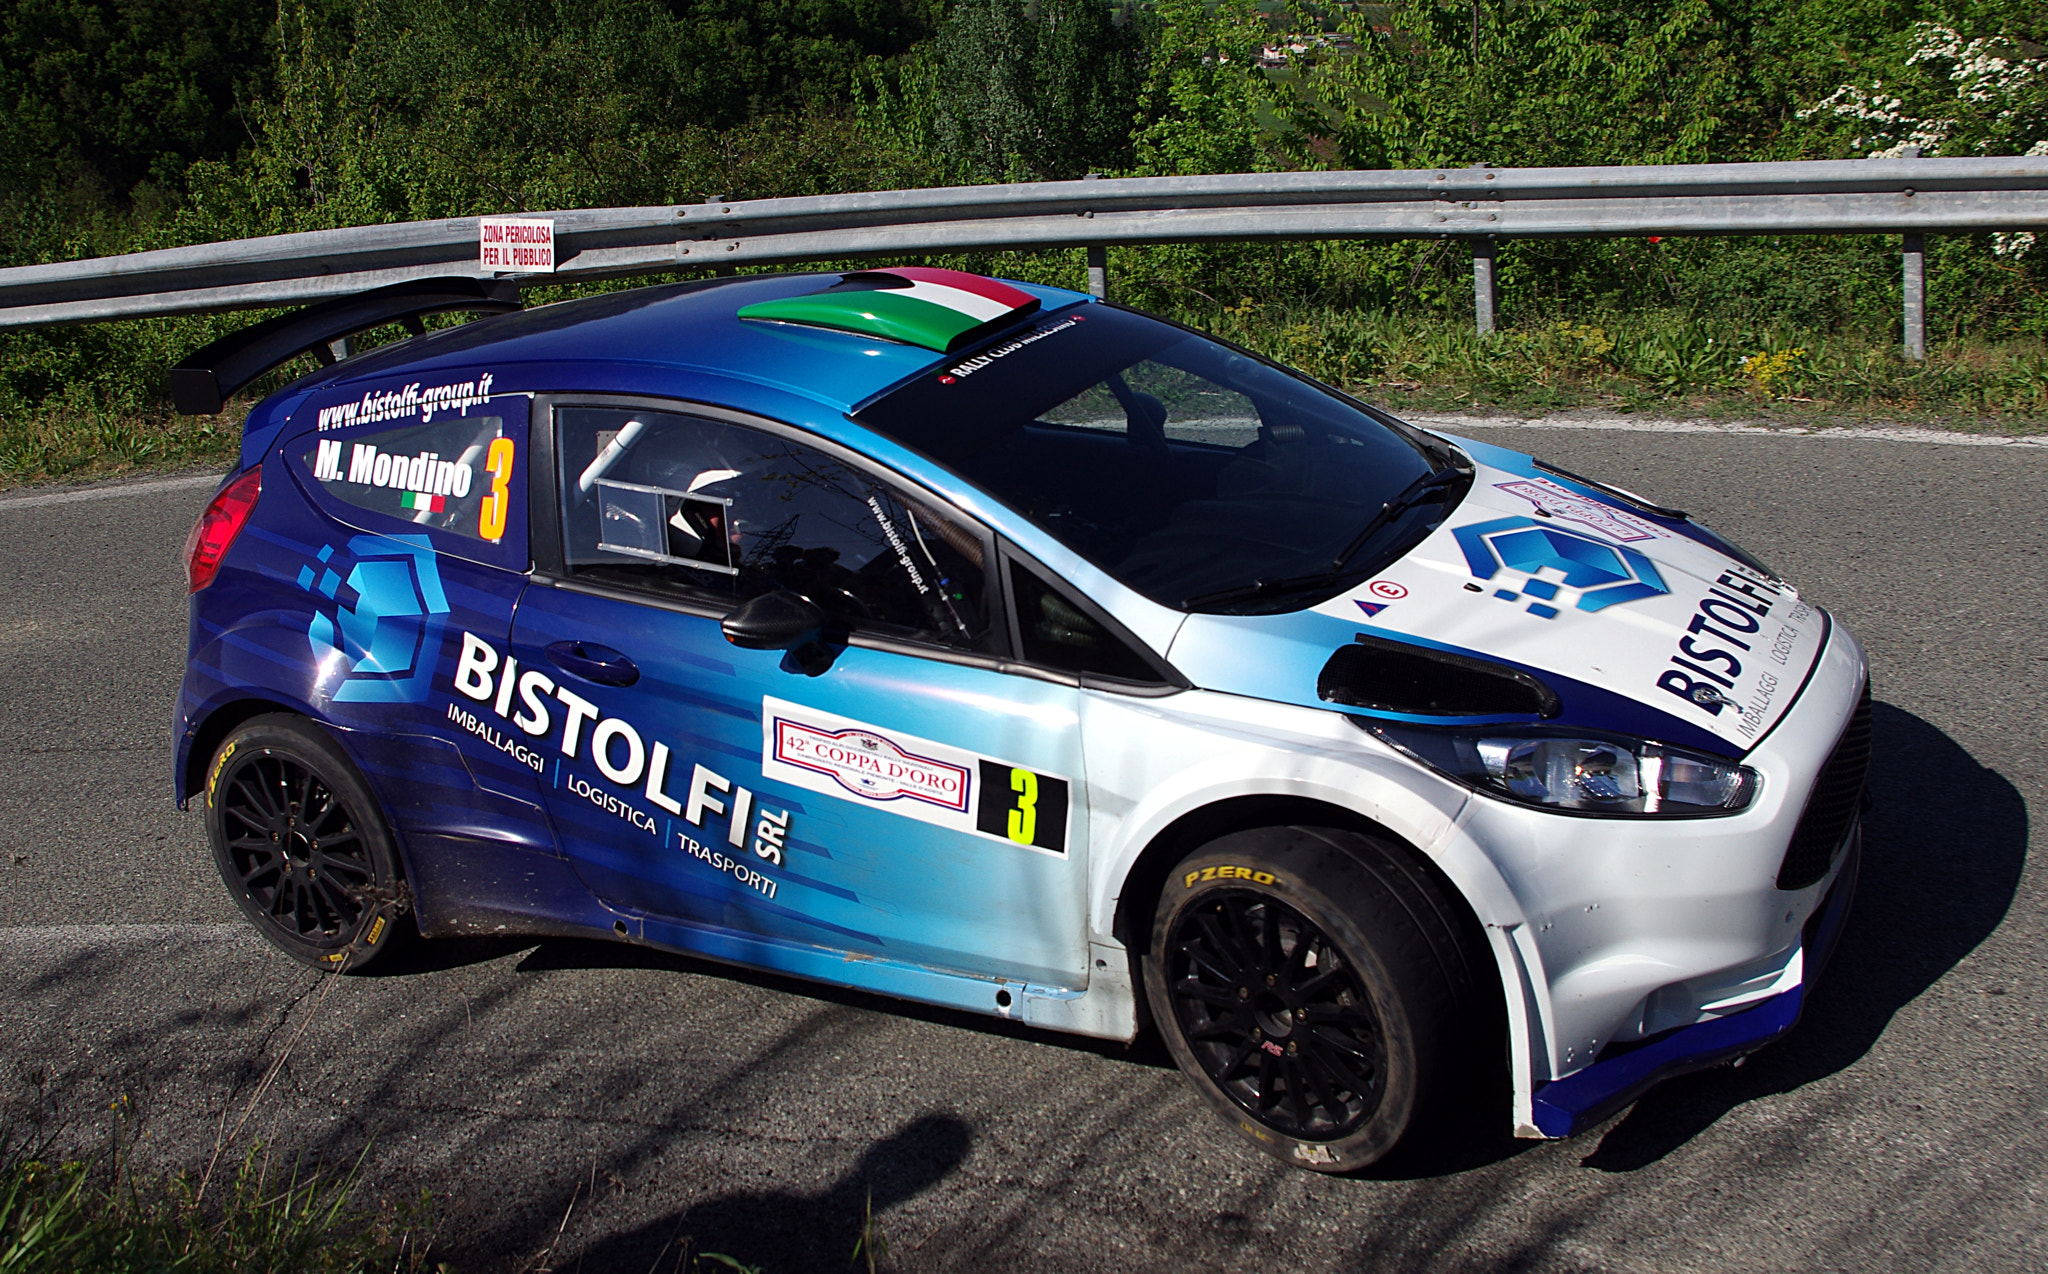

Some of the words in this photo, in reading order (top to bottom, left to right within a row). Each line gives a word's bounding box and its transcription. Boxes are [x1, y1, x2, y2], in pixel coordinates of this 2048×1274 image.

[483, 225, 504, 243] ZONA
[505, 225, 552, 244] PERICOLOSA
[483, 247, 500, 265] PER
[502, 247, 511, 265] IL
[512, 247, 552, 266] PUBBLICO
[949, 354, 994, 378] RALLY
[986, 338, 1023, 358] CLUB
[317, 372, 494, 432] www.bistolfi-group.it
[314, 439, 344, 481] M.
[348, 443, 473, 498] Mondino
[478, 437, 515, 541] 3
[867, 496, 930, 595] www.bistolfi-group.it
[1564, 504, 1614, 530] COPPA
[1655, 568, 1781, 718] BISTOLFI
[1736, 671, 1780, 740] IMBALLAGGI
[1769, 624, 1800, 666] LOGISTICA
[454, 631, 753, 848] BISTOLFI
[754, 808, 789, 866] SRL
[815, 743, 882, 774] COPPA
[888, 762, 957, 792] D'ORO
[447, 703, 545, 773] IMBALLAGGI
[567, 773, 657, 835] LOGISTICA
[677, 832, 777, 899] TRASPORTI
[1006, 766, 1039, 846] 3
